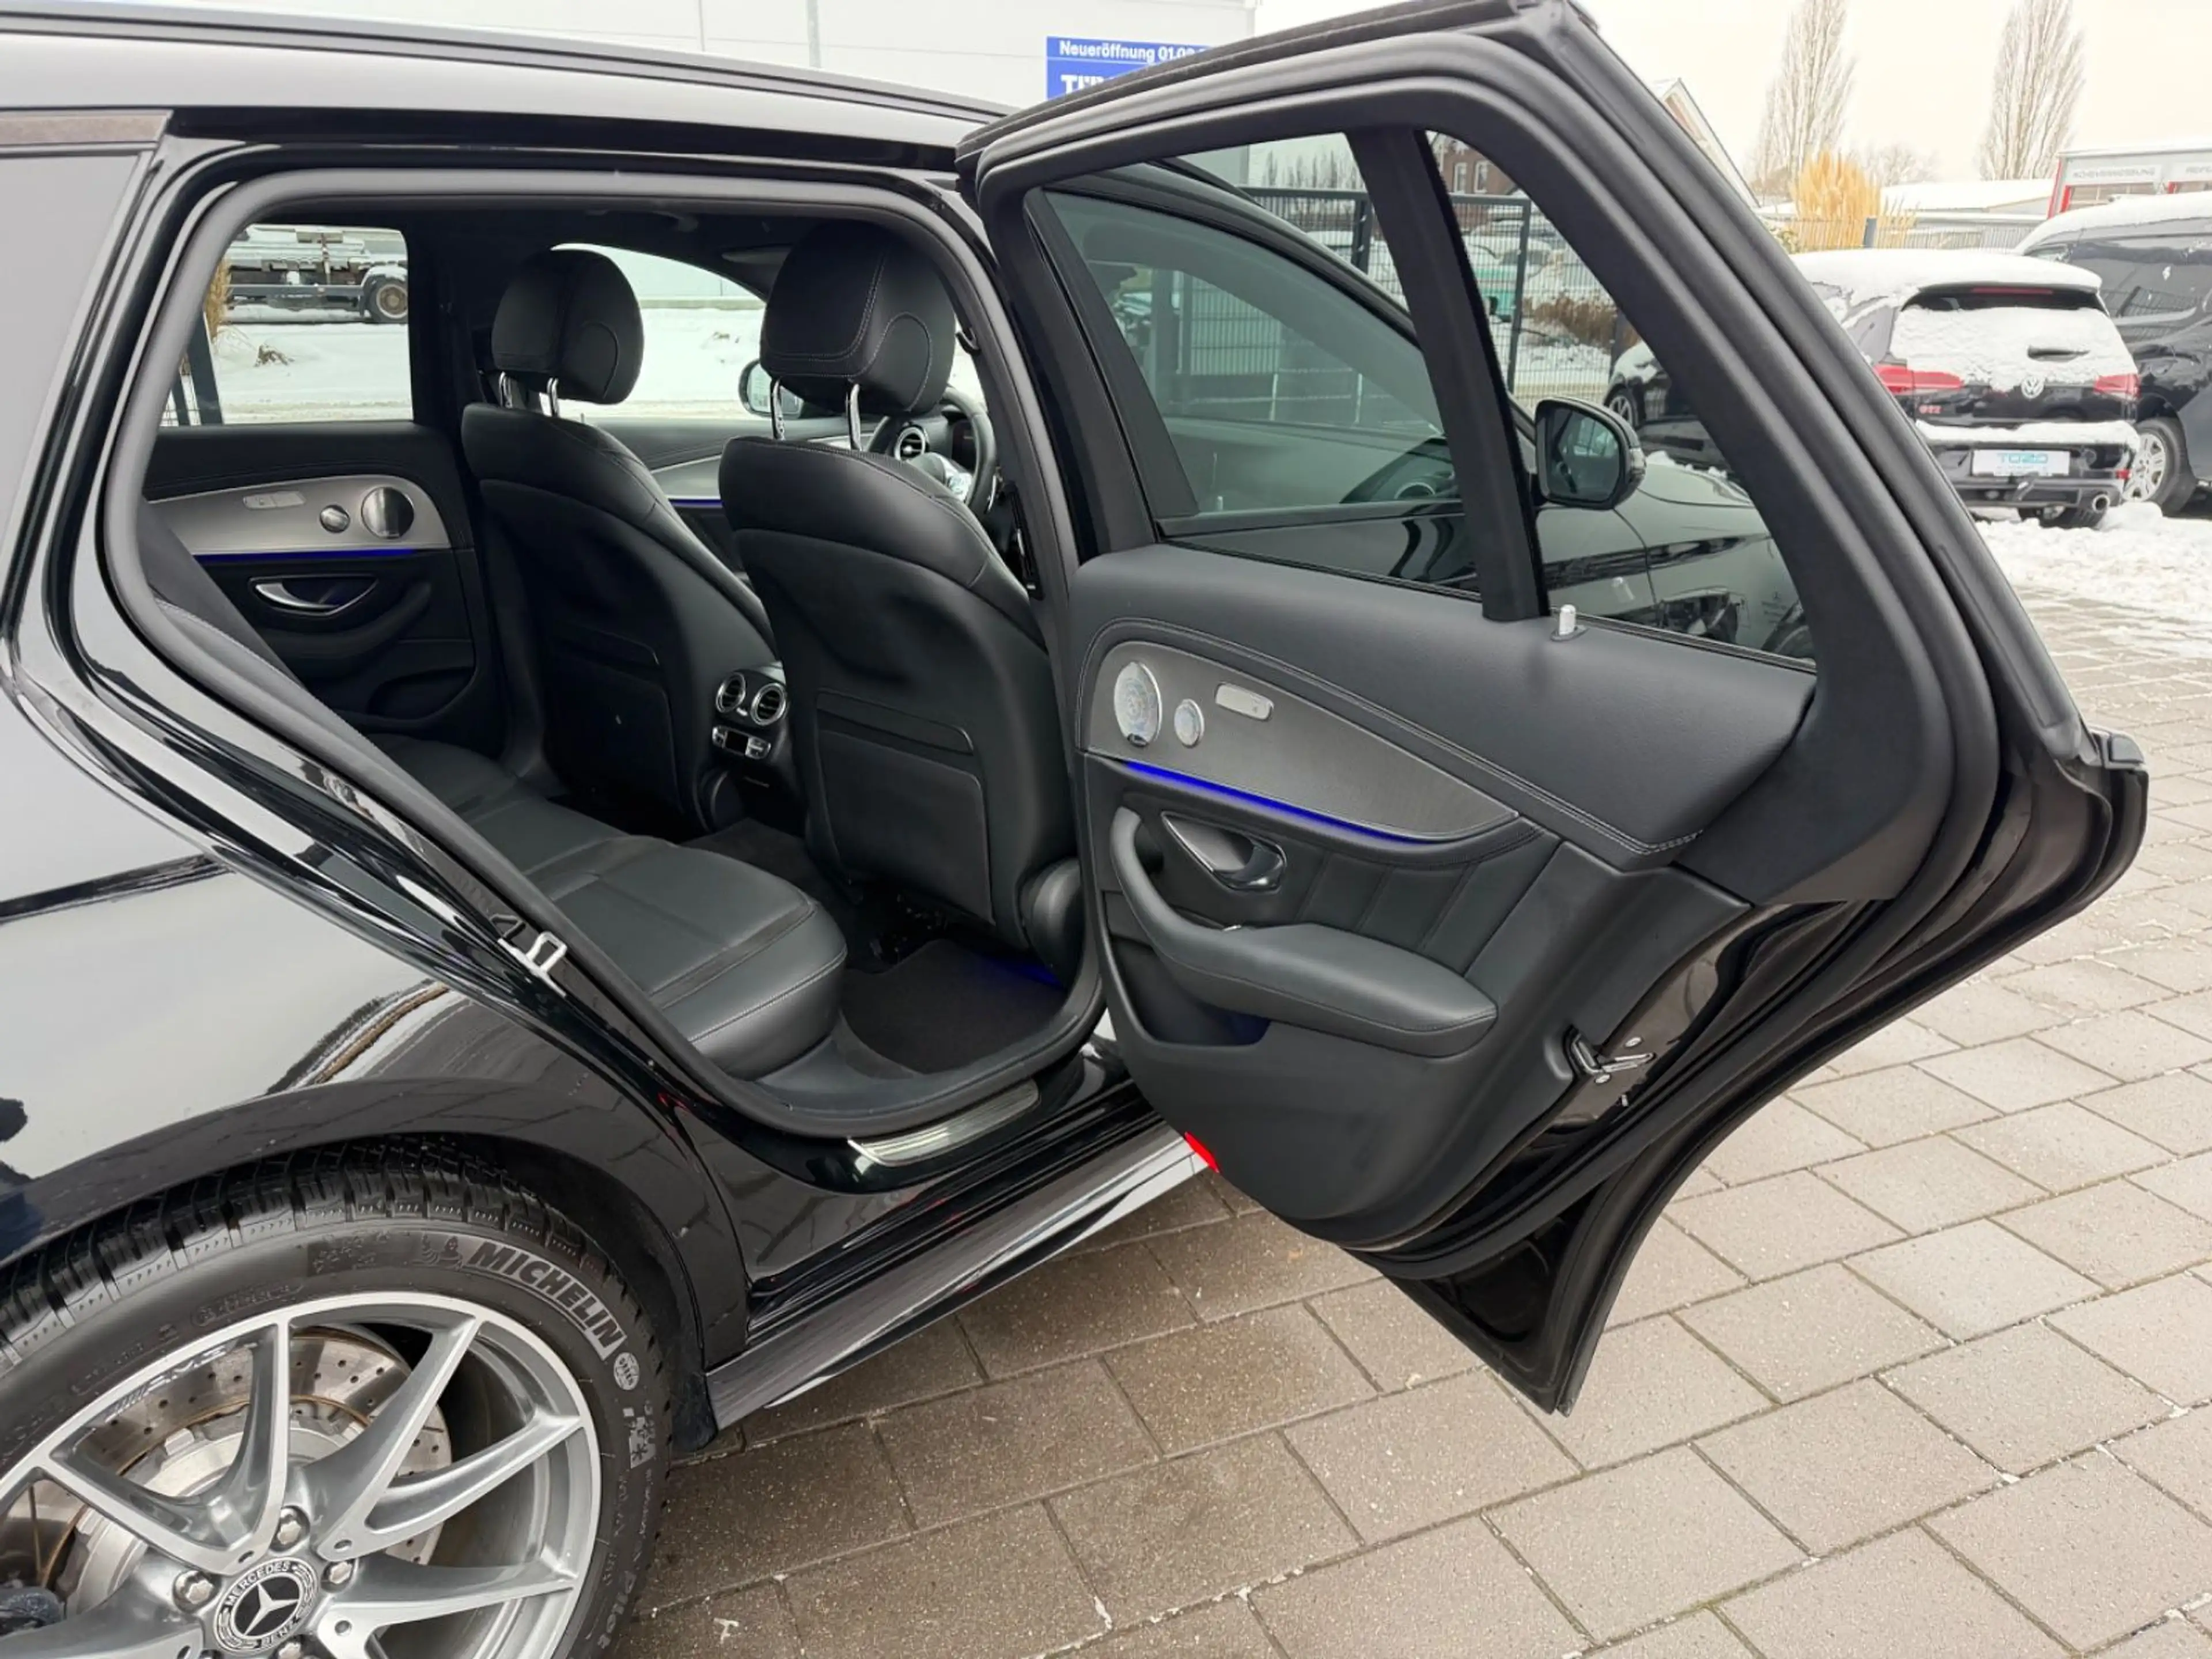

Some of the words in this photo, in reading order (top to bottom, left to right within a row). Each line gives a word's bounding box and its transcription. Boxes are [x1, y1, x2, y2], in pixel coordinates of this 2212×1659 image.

[1059, 40, 1155, 63] Neueröffnung
[467, 1241, 624, 1349] MICHELIN
[225, 1562, 290, 1605] MERCEDES
